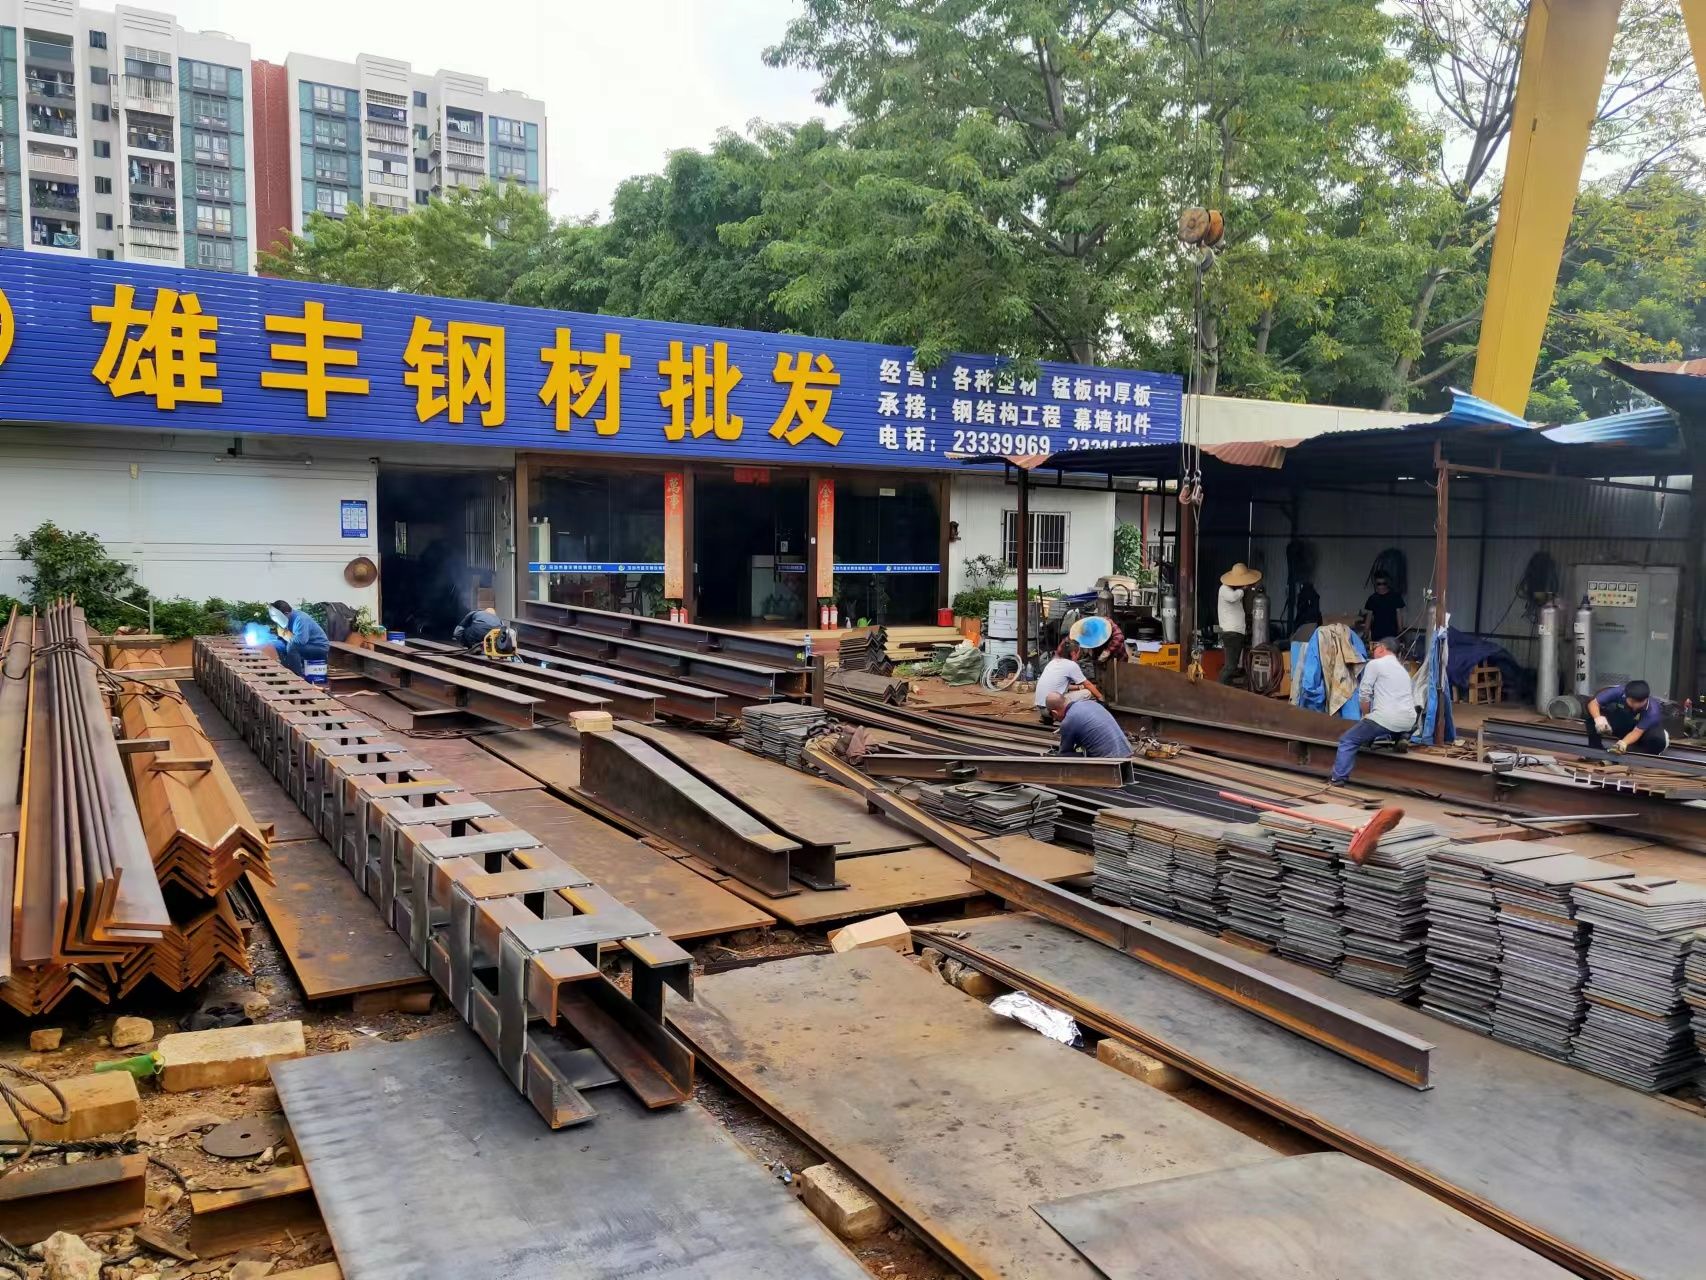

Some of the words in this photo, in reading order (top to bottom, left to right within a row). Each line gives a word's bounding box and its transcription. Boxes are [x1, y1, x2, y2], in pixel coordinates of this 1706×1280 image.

[92, 283, 844, 446] 雄丰钢材批发
[1073, 407, 1152, 436] 幕墙扣件
